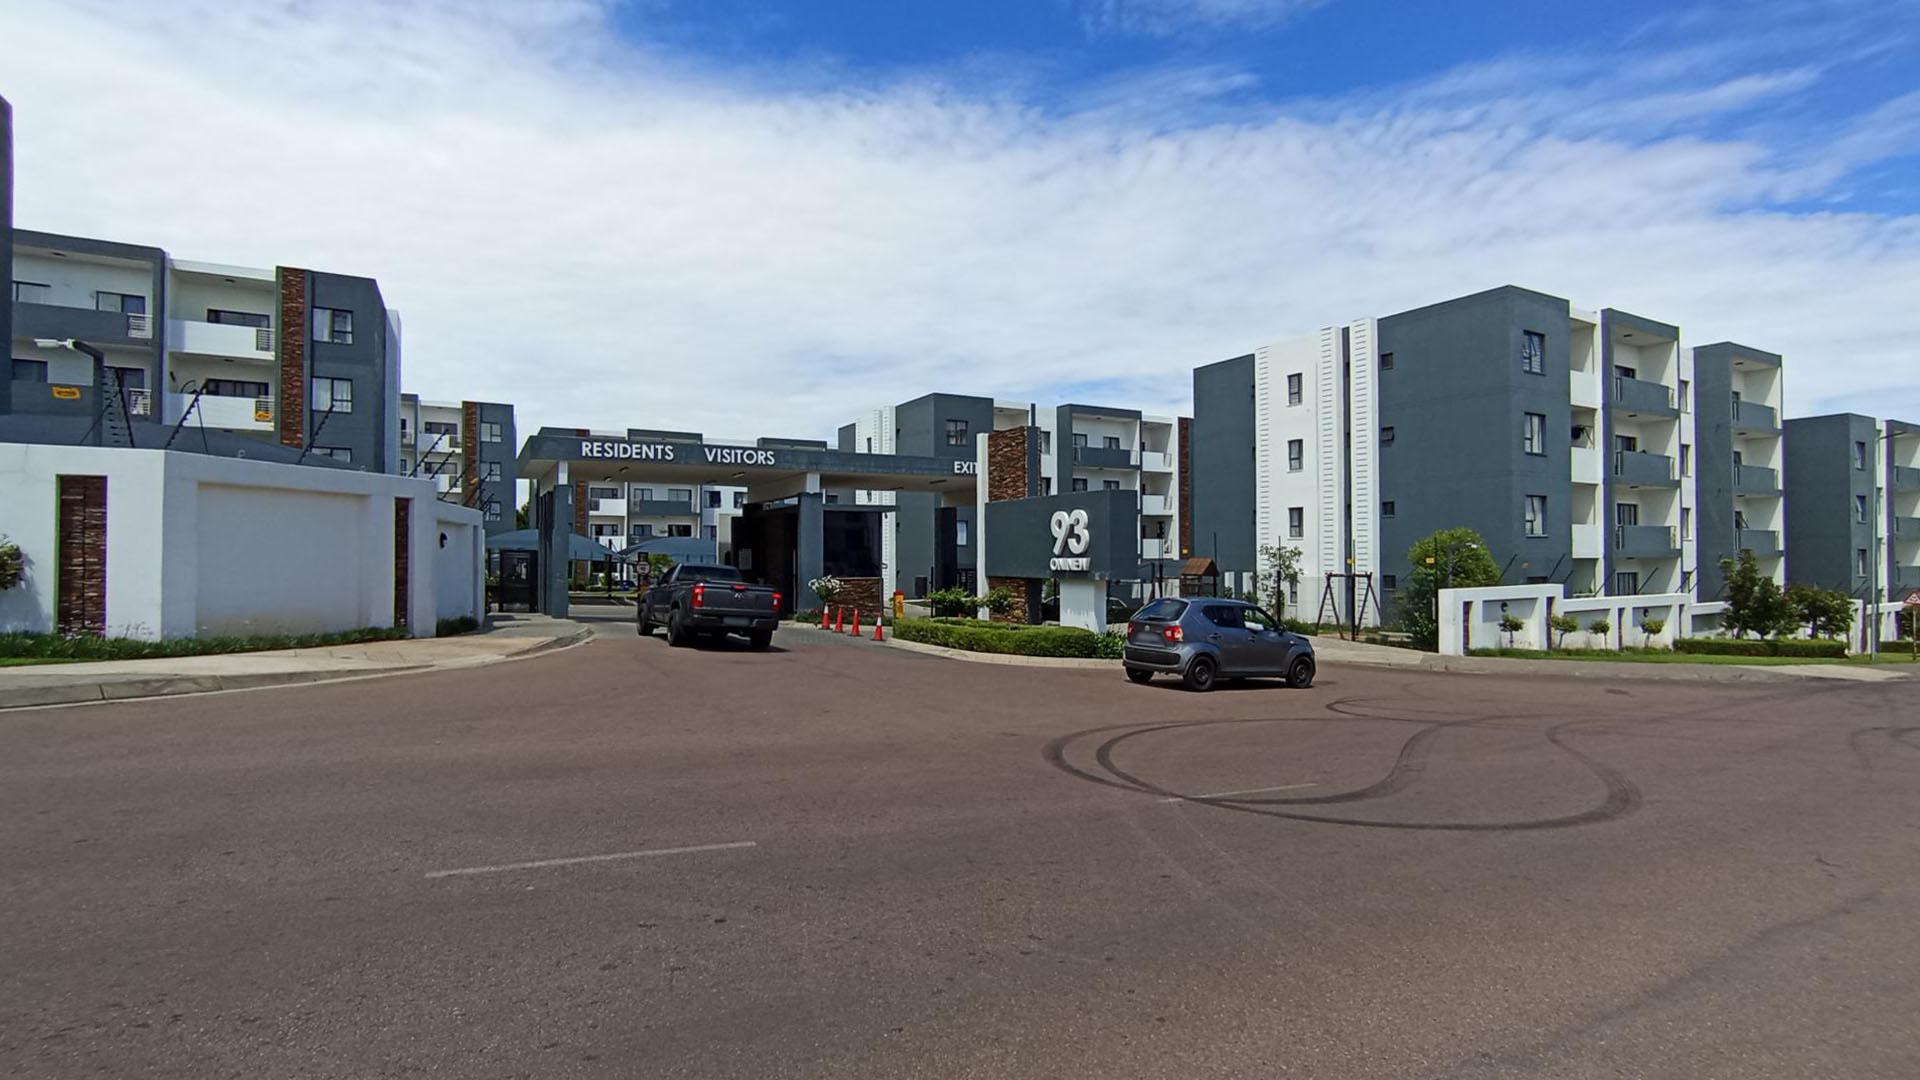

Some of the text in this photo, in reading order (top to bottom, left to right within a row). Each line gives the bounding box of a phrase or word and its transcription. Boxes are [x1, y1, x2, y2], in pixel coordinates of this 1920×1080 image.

[581, 441, 674, 460] RESIDENTS
[704, 447, 775, 465] VISITORS
[1050, 509, 1090, 556] 93
